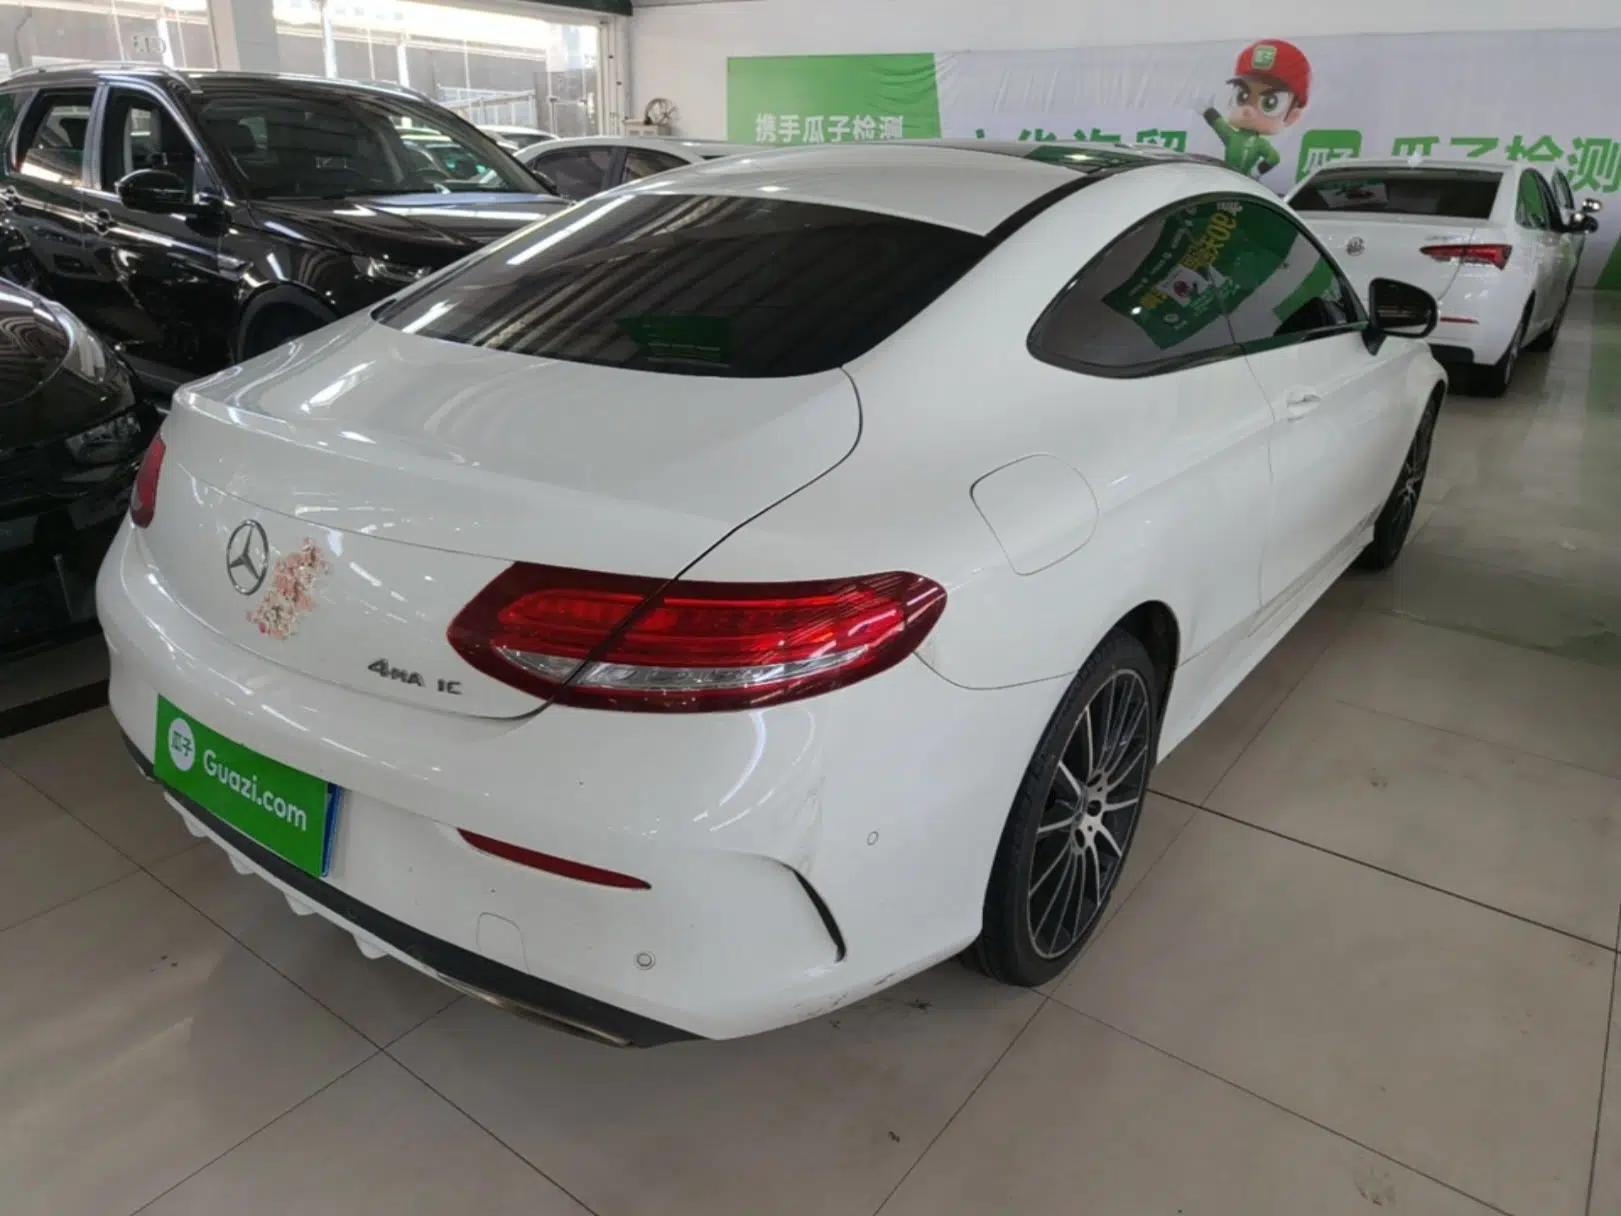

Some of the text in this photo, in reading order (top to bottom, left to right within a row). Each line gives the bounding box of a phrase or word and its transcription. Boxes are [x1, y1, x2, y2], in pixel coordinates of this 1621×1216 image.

[755, 113, 904, 143] 携手瓜子检测
[203, 749, 307, 832] Guazi.com
